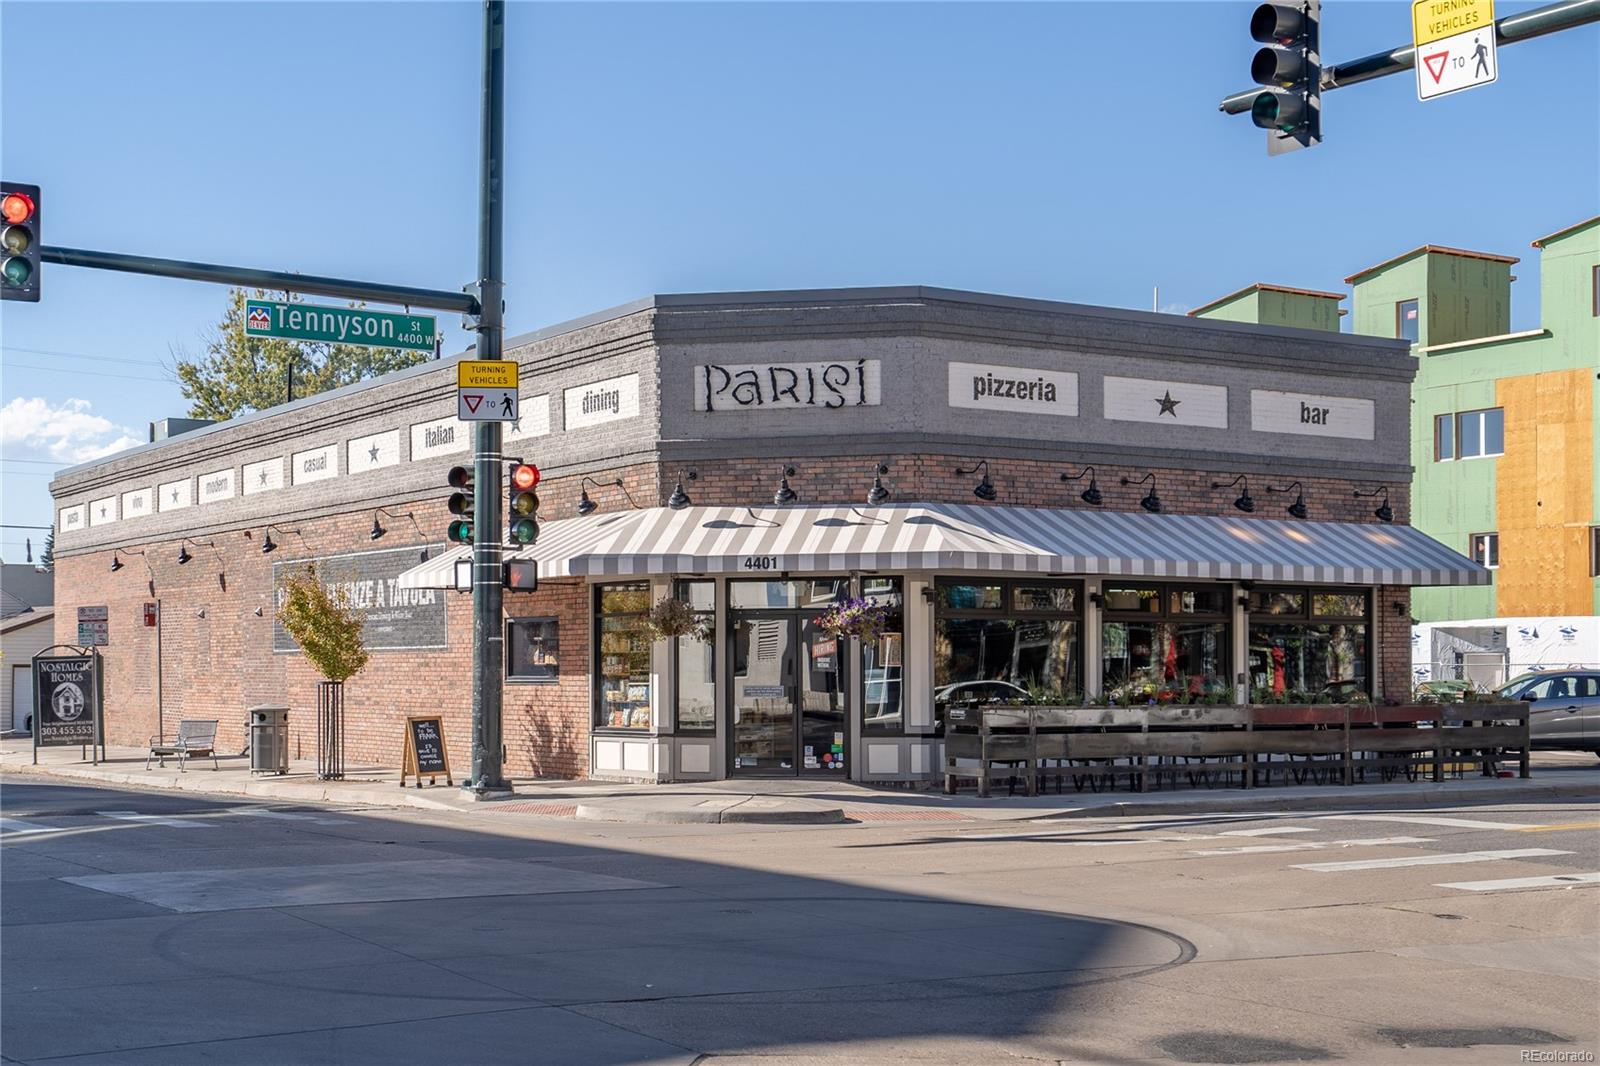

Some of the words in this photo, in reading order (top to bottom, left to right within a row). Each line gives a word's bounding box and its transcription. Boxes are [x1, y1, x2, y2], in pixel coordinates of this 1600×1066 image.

[1428, 11, 1479, 35] VEHICLES
[1452, 56, 1465, 70] TO
[275, 305, 394, 341] Tennyson
[411, 321, 421, 332] St
[397, 333, 423, 345] 4400
[425, 335, 434, 345] W
[471, 365, 506, 374] TURNING
[469, 376, 508, 385] VEHICLES
[972, 373, 1057, 402] pizzeria
[486, 400, 496, 409] TO
[582, 388, 620, 415] dining
[1300, 401, 1330, 426] bar
[425, 425, 455, 448] italian
[303, 452, 328, 473] casual
[205, 477, 228, 495] modern
[744, 556, 777, 570] 4401
[376, 579, 386, 608] A
[40, 661, 93, 673] NOSTALGIC
[51, 673, 84, 683] HOMES
